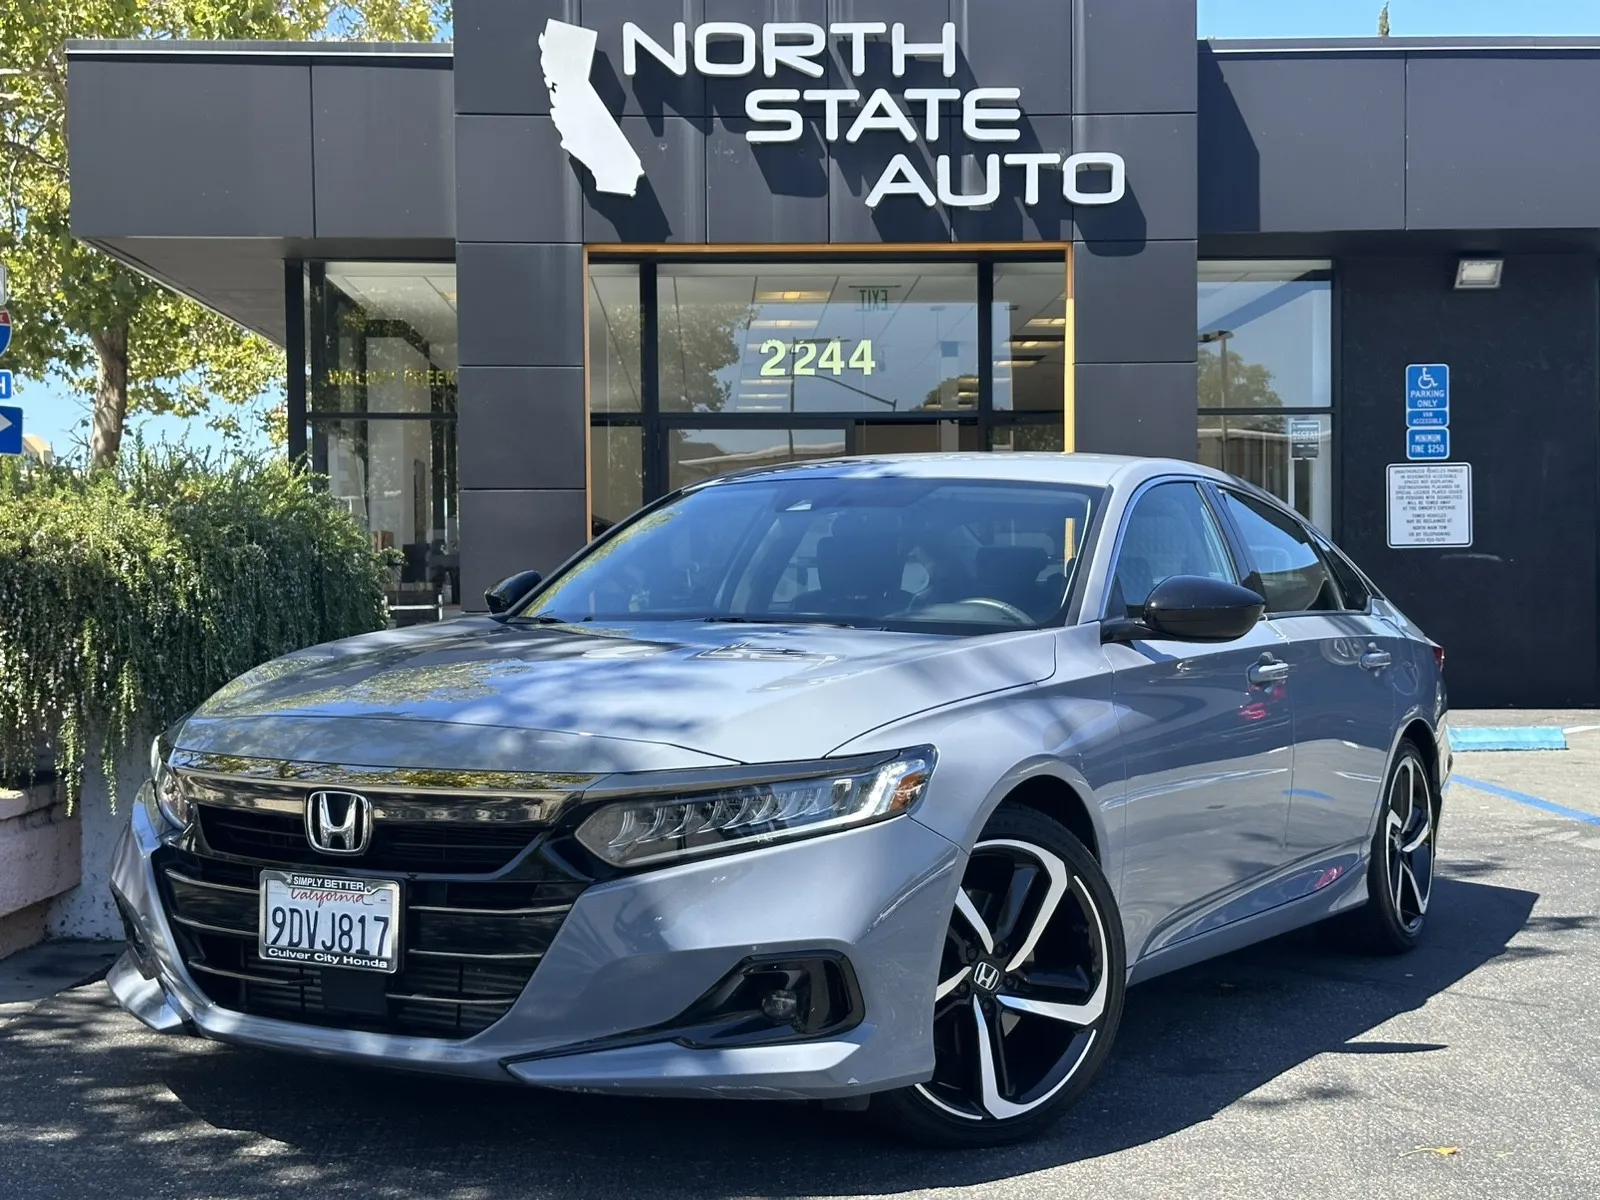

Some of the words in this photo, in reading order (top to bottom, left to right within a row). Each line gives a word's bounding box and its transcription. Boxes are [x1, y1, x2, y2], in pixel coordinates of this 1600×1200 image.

[622, 21, 956, 77] NORTH
[745, 87, 1021, 142] STATE
[865, 152, 1125, 207] AUTO
[759, 338, 876, 376] 2244
[1410, 390, 1445, 398] PARKING
[1416, 399, 1438, 407] ONLY
[1411, 444, 1425, 453] FINE
[1427, 444, 1445, 453] $250
[1414, 434, 1441, 442] MINIMUM
[293, 876, 322, 887] SIMPLY
[324, 880, 364, 891] BETTER
[270, 906, 389, 957] 9DVJ817
[268, 948, 311, 960] Culver
[314, 952, 339, 964] City
[343, 955, 388, 969] Honda
